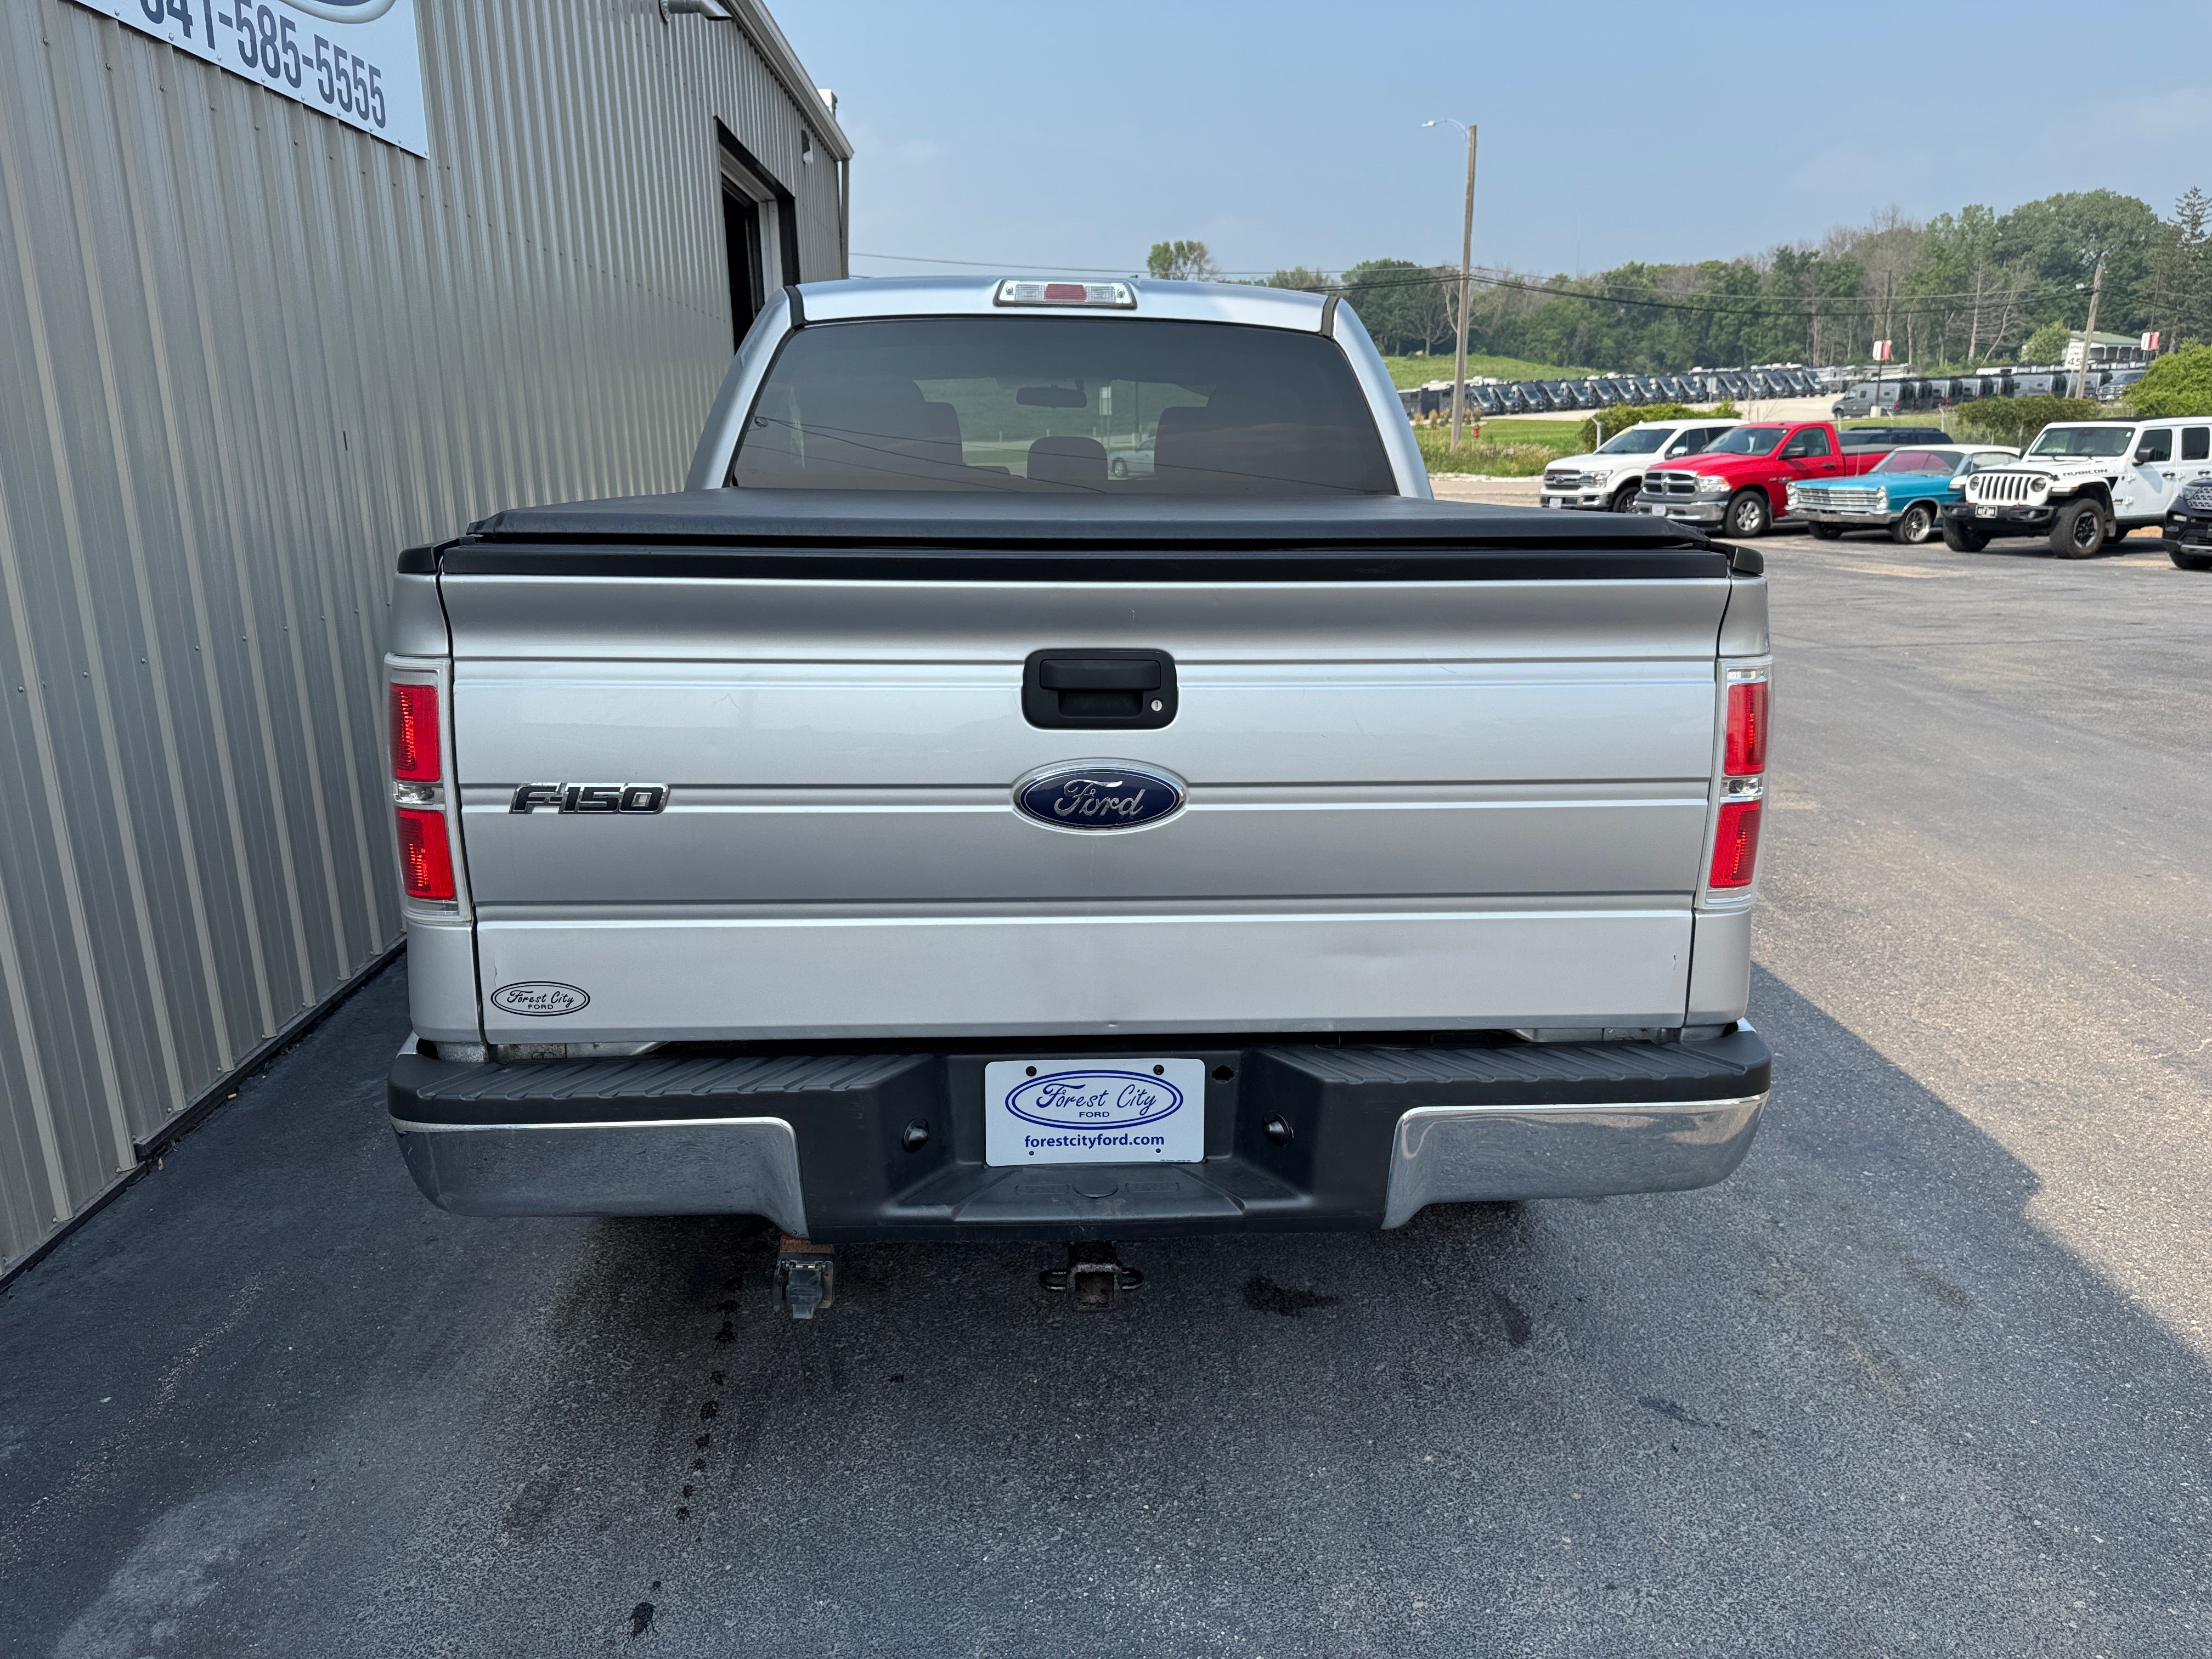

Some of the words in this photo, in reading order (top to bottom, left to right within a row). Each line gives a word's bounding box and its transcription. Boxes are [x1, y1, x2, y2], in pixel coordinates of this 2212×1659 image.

[2067, 357, 2084, 366] 45
[509, 782, 672, 815] F-150
[1053, 778, 1146, 816] Ford
[506, 990, 547, 1003] Forest
[550, 991, 574, 1008] City
[1036, 1083, 1109, 1108] Forest
[1116, 1084, 1157, 1116] City
[1024, 1133, 1165, 1149] forestcityford.com
